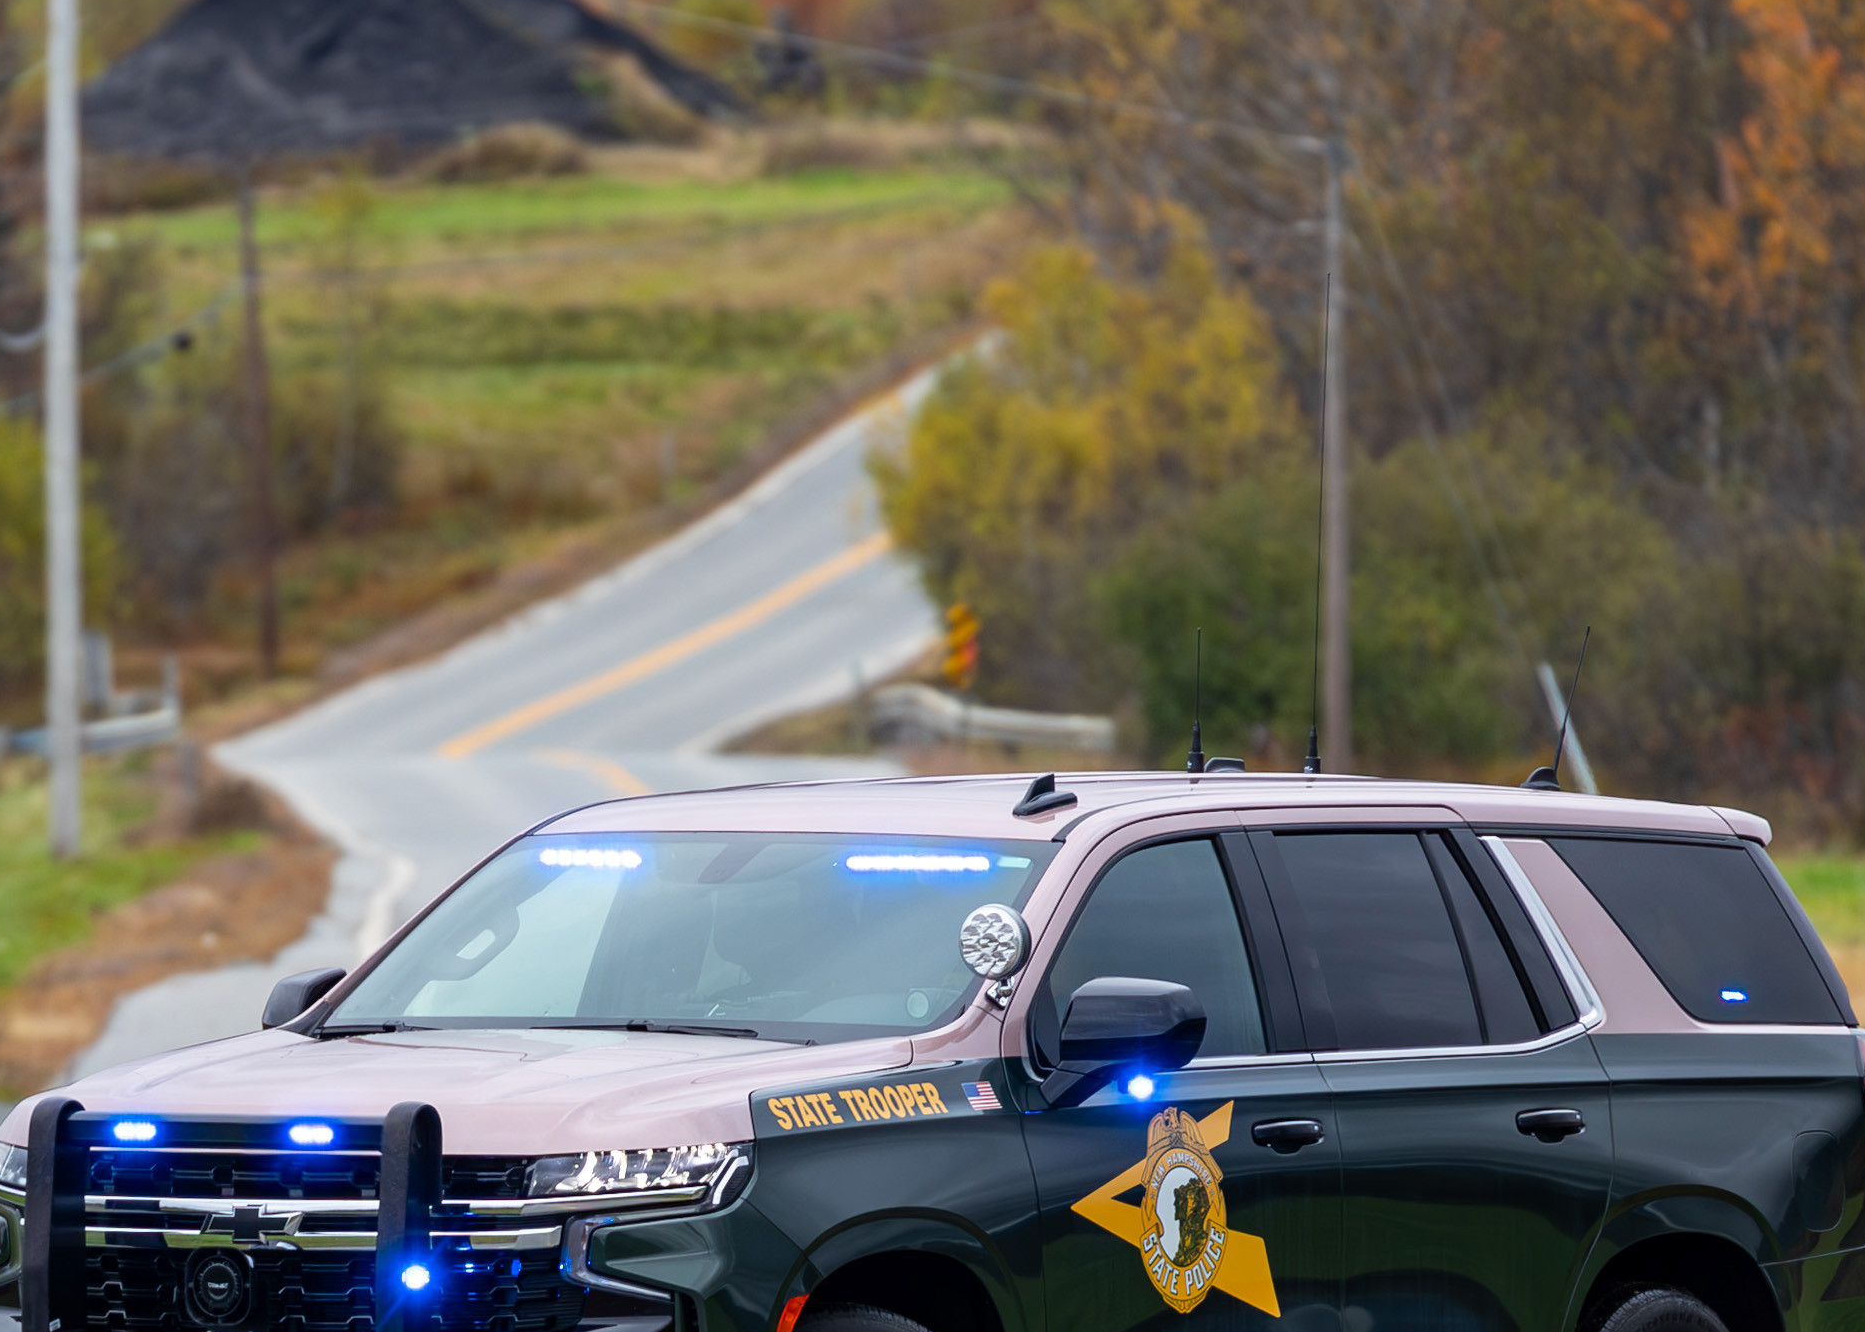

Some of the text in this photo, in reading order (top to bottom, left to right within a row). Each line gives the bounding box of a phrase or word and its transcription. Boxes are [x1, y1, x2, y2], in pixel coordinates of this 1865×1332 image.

[768, 1082, 949, 1130] STATE TROOPER
[1151, 1152, 1212, 1190] NEW HAMPSHIRE
[1143, 1226, 1225, 1295] STATE POLICE
